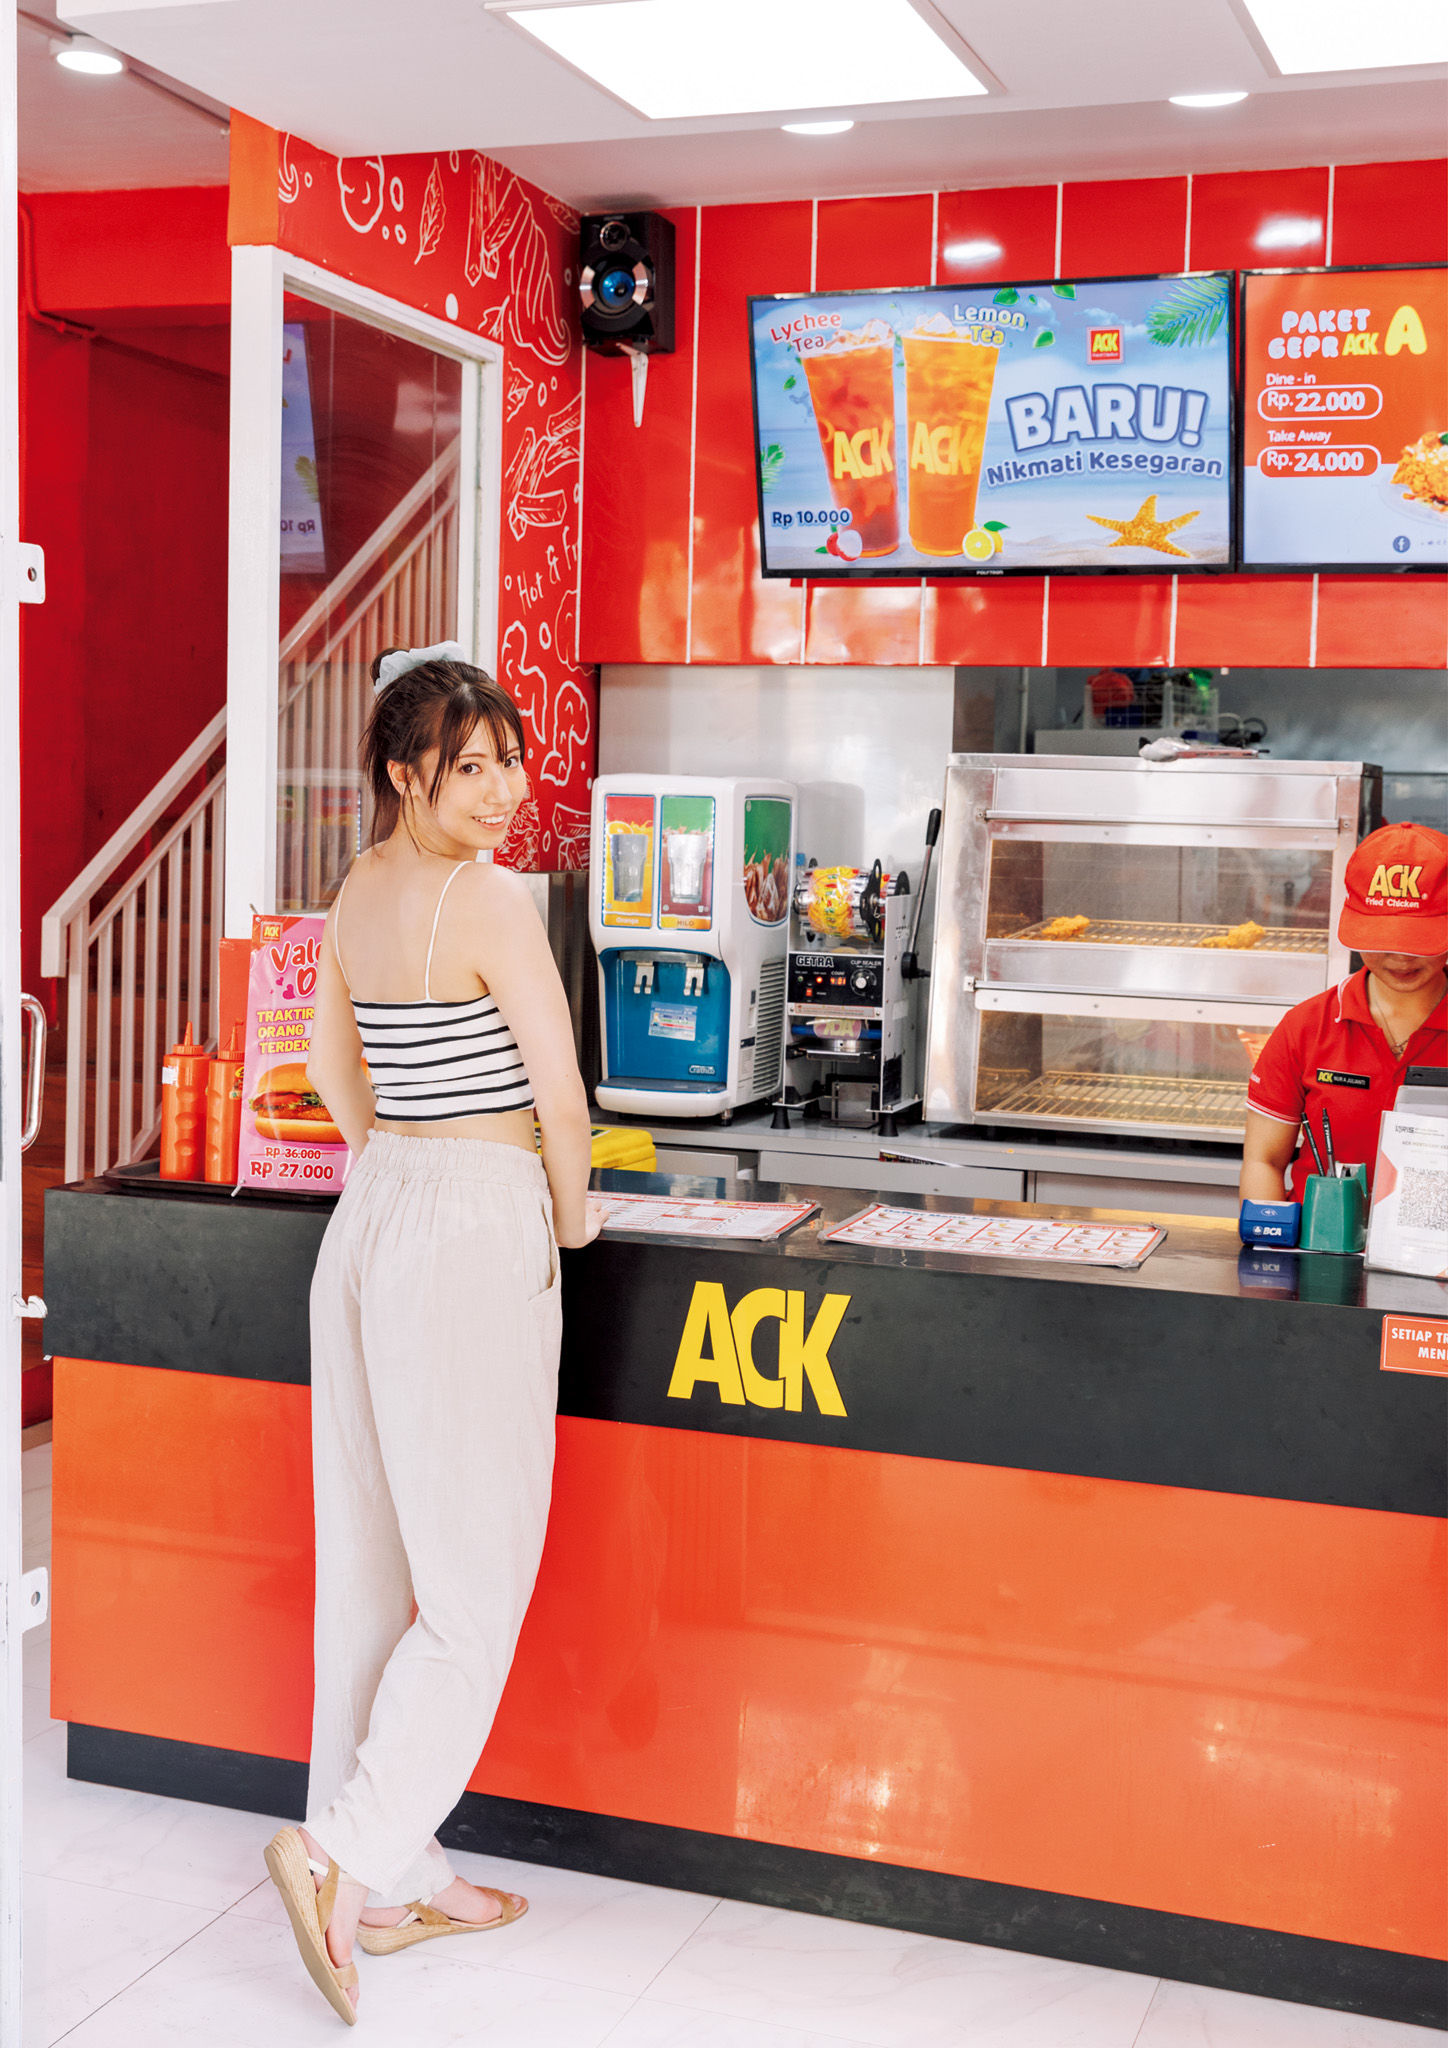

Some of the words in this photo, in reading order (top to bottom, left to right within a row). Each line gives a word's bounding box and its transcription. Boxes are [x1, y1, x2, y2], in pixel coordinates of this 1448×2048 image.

[953, 304, 1026, 329] Lemon
[1281, 308, 1371, 334] PAKET
[770, 313, 842, 342] Lychee
[970, 325, 1005, 345] Tea
[1384, 304, 1428, 356] A
[792, 335, 825, 353] Tea
[1092, 333, 1119, 353] ACK
[1268, 335, 1339, 359] GEPR
[1341, 332, 1380, 356] ACK
[1265, 372, 1295, 386] Dine
[1303, 372, 1317, 385] in
[1267, 391, 1294, 411] Rp.
[1294, 391, 1366, 412] 22.000
[1005, 383, 1208, 452] BARU!
[1267, 430, 1296, 443] Take
[1297, 429, 1332, 444] Away
[833, 418, 895, 480] ACK
[910, 420, 978, 476] ACK
[986, 449, 1082, 486] Nikmati
[1089, 450, 1222, 476] Kesegaran
[1266, 450, 1293, 470] Rp.
[1293, 450, 1364, 472] 24.000
[772, 511, 792, 526] Rp
[797, 510, 850, 523] 10.000
[517, 571, 543, 616] Hot
[1367, 863, 1423, 899] ACK
[1365, 897, 1384, 906] Fried
[1387, 899, 1420, 909] Chicken
[264, 926, 280, 938] ACK
[796, 955, 835, 968] GETRA
[256, 1007, 315, 1023] TRAKTIR
[257, 1023, 304, 1039] ORANG
[259, 1038, 311, 1055] TERDEK
[1317, 1071, 1333, 1083] ACK
[284, 1147, 321, 1160] 36.000
[278, 1162, 334, 1180] 27.000
[1262, 1227, 1282, 1236] BCA
[1391, 1327, 1433, 1343] SETIAP
[667, 1280, 852, 1417] ACK
